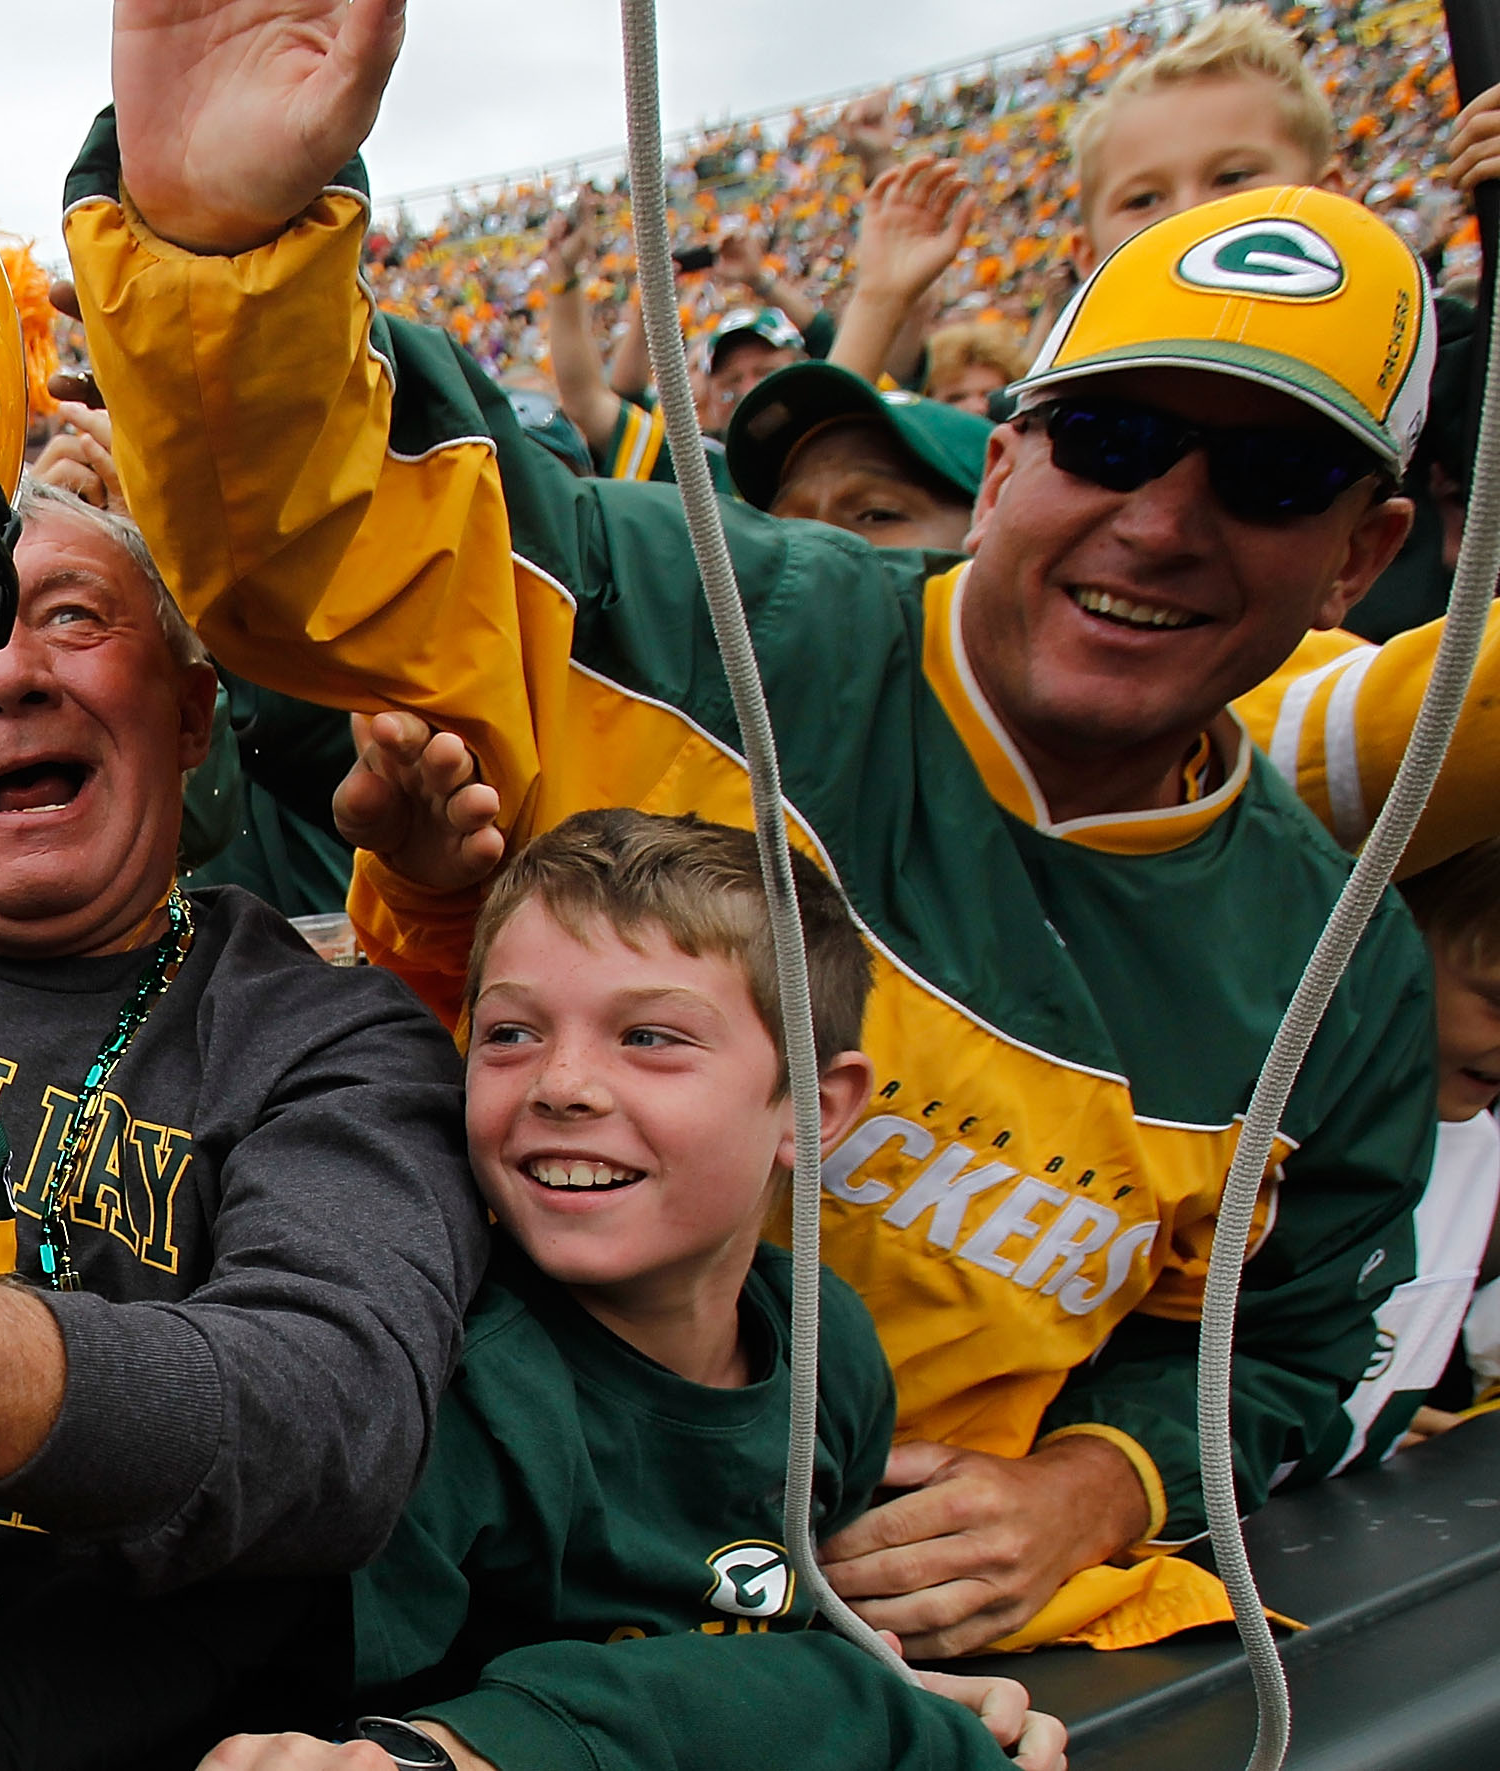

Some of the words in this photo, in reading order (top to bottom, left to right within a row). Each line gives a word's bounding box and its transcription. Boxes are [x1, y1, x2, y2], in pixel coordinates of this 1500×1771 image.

[1178, 217, 1344, 298] G
[879, 1080, 1012, 1149] REEN
[1044, 1155, 1136, 1201] BAY
[821, 1114, 1162, 1316] CKERS
[707, 1544, 791, 1619] G
